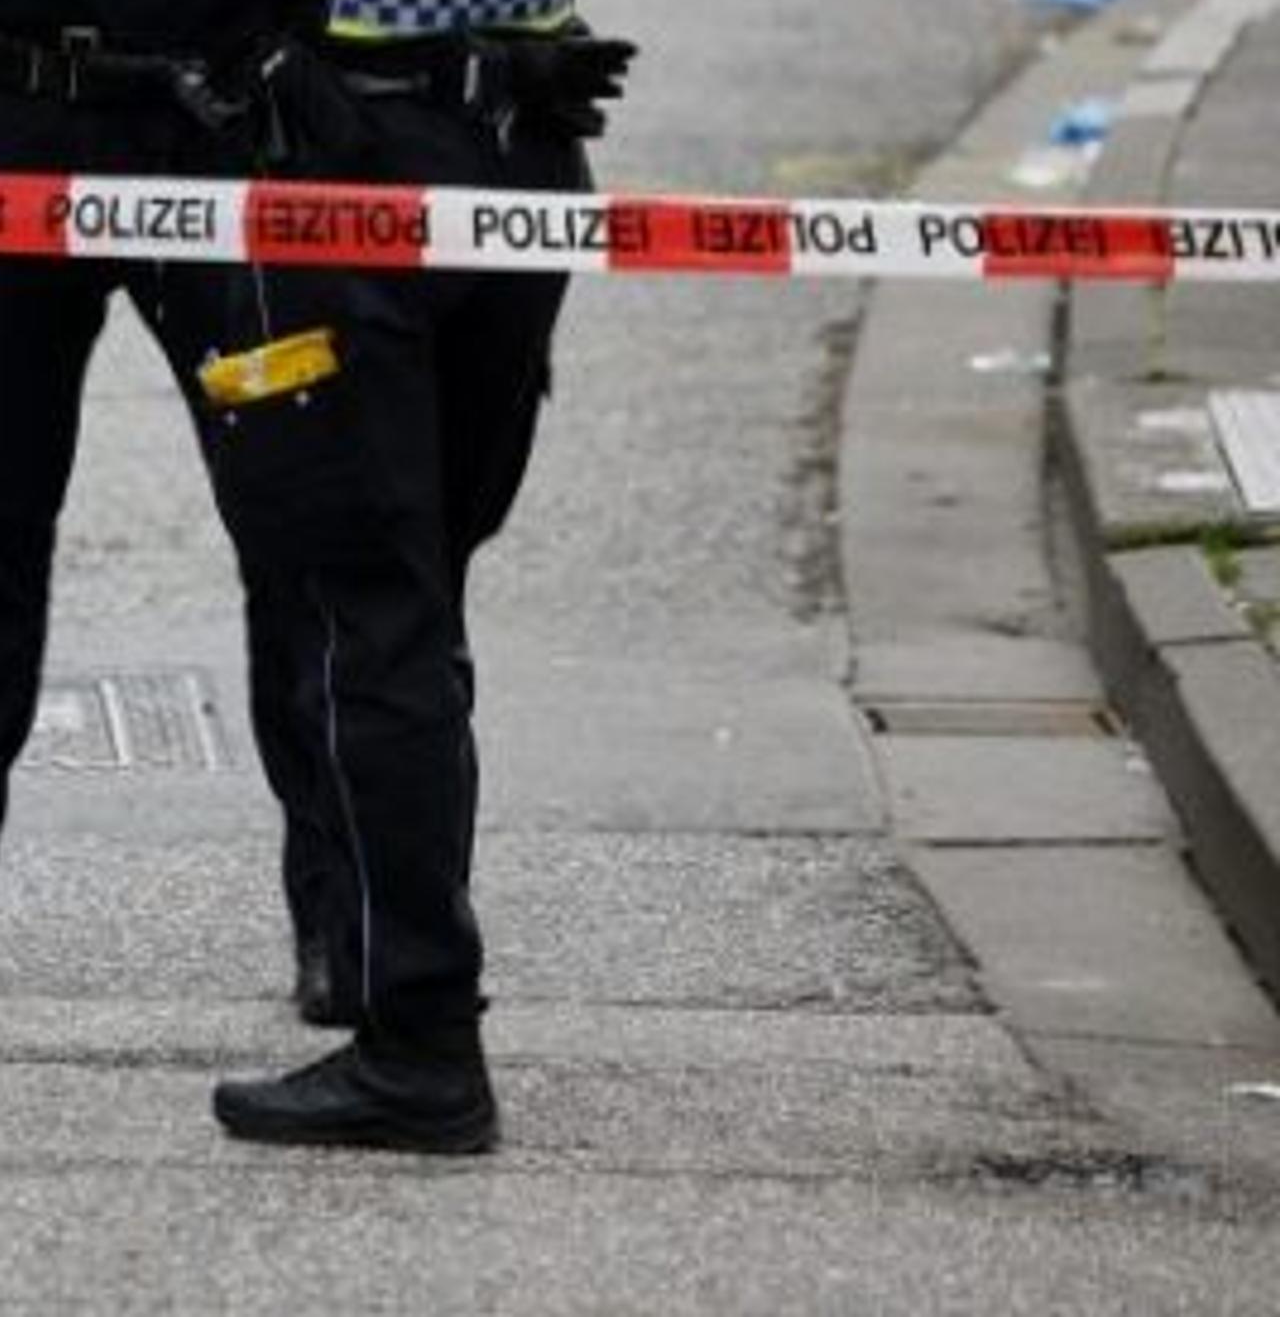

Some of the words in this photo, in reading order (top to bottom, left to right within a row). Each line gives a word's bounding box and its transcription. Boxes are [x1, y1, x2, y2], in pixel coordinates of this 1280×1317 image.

[45, 192, 216, 241] POLIZEI
[252, 198, 430, 248] POLIZEI
[472, 204, 649, 254] POLIZEI
[693, 211, 877, 256] POLIZEI
[917, 213, 1108, 258] POLIZEI
[1149, 218, 1280, 259] LIZEI
